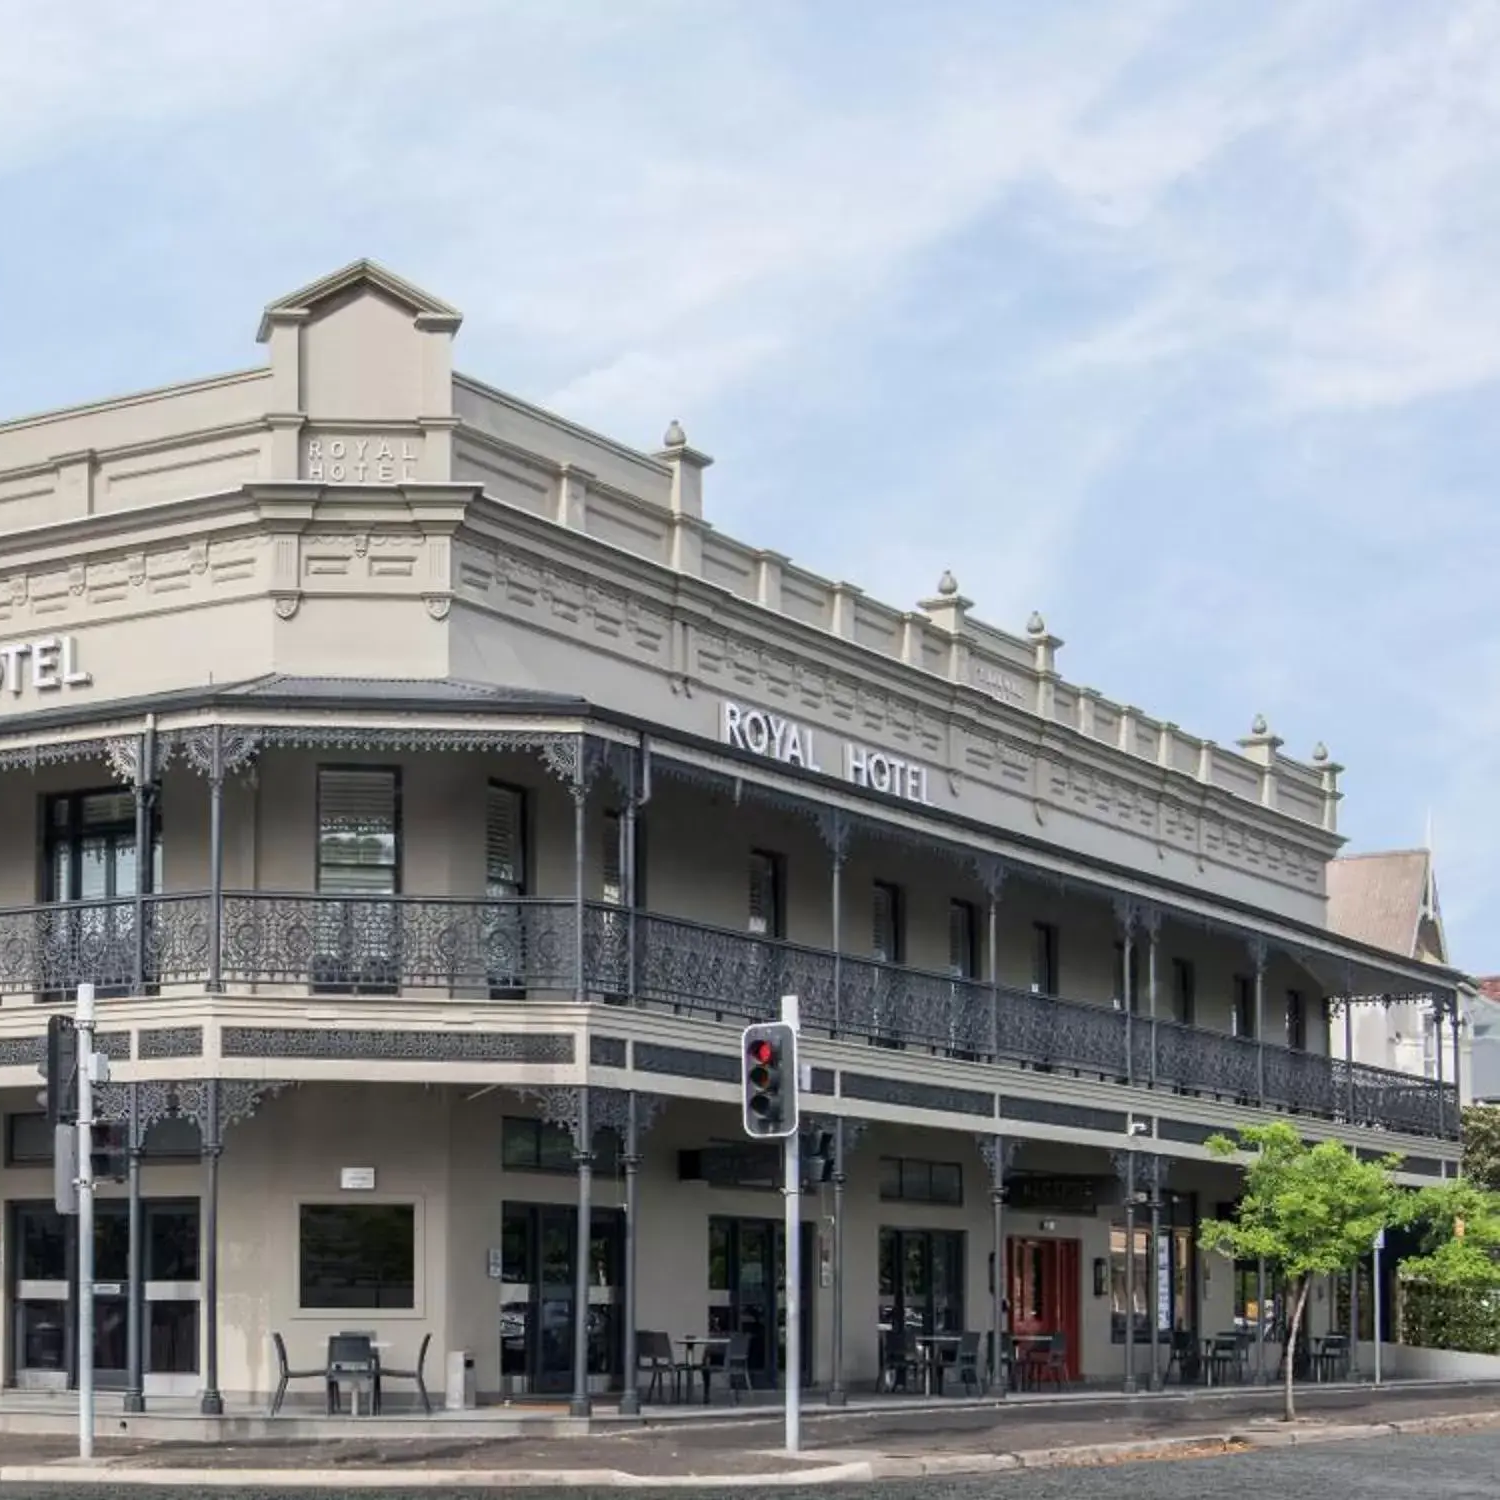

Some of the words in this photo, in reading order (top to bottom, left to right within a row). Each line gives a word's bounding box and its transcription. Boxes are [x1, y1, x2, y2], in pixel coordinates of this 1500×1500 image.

[307, 440, 417, 461] ROYAL
[307, 462, 417, 482] HOTEL
[722, 701, 821, 772] ROYAL
[846, 743, 934, 805] HOTEL
